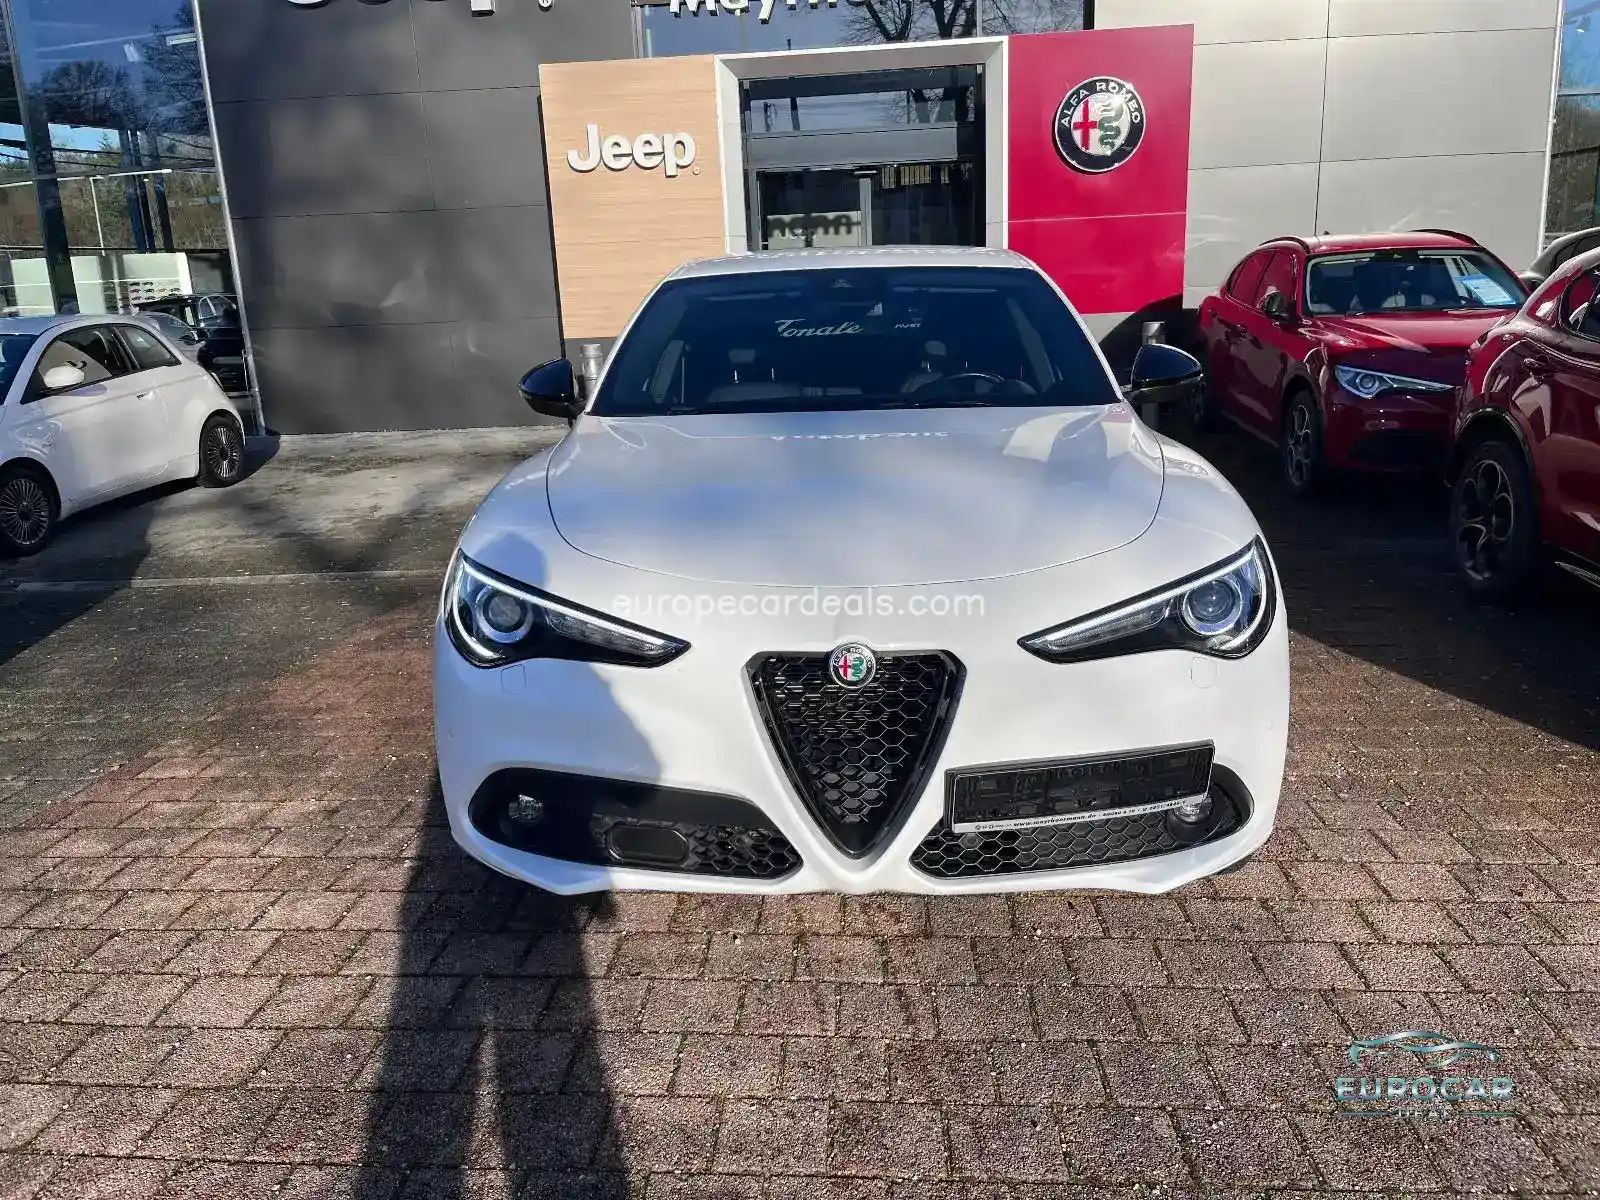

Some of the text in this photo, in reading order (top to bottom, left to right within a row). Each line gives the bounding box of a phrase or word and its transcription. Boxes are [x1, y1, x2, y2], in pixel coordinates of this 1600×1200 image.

[1060, 81, 1141, 128] ALFA ROMEO
[566, 123, 697, 178] Jeep
[774, 318, 864, 338] Tonale
